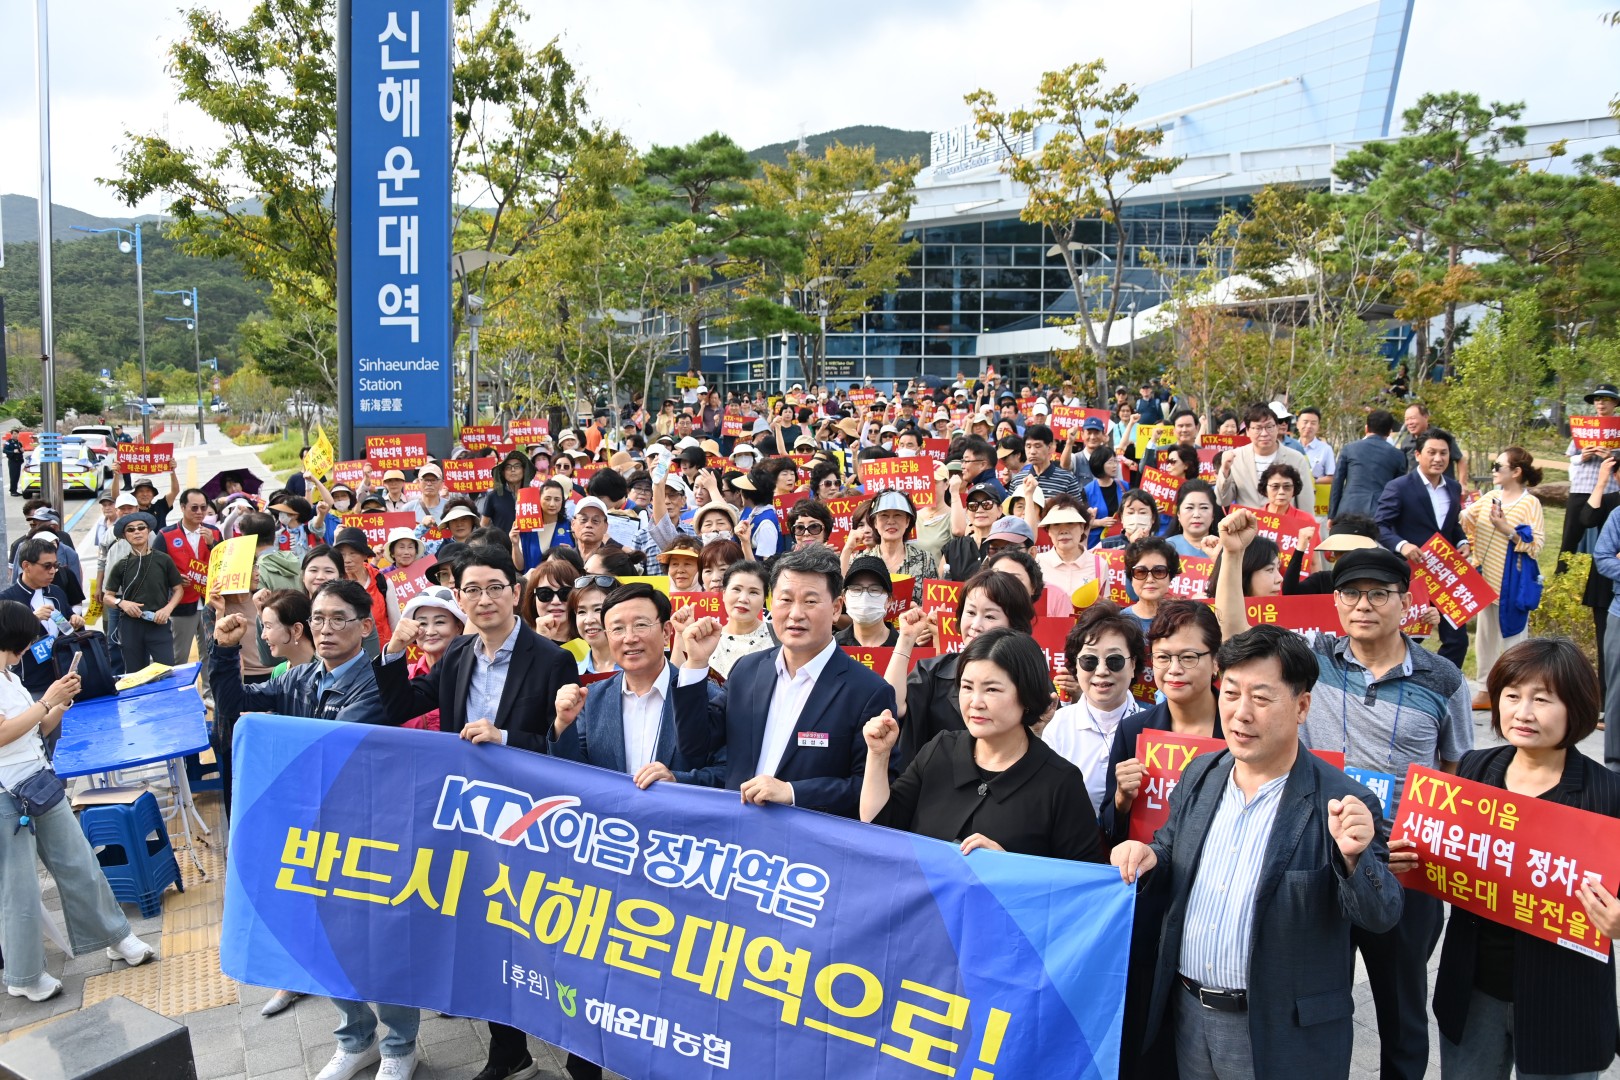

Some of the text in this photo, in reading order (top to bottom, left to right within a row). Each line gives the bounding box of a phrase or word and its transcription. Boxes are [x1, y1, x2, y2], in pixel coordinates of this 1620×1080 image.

[377, 10, 420, 344] 신해운대역
[359, 357, 440, 372] Sinhaeundae
[359, 378, 402, 392] Station
[359, 398, 403, 412] 新海雲臺
[1053, 406, 1086, 417] KTX-이음
[1570, 416, 1601, 427] KTX-이음
[1572, 427, 1601, 439] 신해운대역
[368, 437, 401, 447] KTX-이음
[1202, 435, 1234, 445] KTX-이음
[118, 444, 151, 453] KTX-이음
[369, 446, 424, 459] 신해운대역 정차로
[119, 453, 171, 463] 신해운대역 정차로
[378, 457, 427, 469] 해운대 발전을!
[707, 458, 727, 466] X-이음
[127, 463, 147, 472] 해운대
[334, 462, 362, 471] KTX-이음
[444, 461, 474, 470] KTX-이음
[891, 460, 920, 475] 해운대
[335, 470, 364, 481] 신해운대역
[446, 470, 475, 481] 신해운대역
[1144, 468, 1179, 489] KTX-이음
[453, 480, 495, 491] 해운대 발전을
[1142, 479, 1177, 502] 신해운대역
[521, 502, 539, 515] 정차로
[344, 516, 384, 527] KTX-이음
[520, 518, 541, 529] 발전을!
[363, 529, 386, 542] 운대역
[1429, 536, 1469, 576] KTX-이음
[1421, 549, 1479, 613] 신해운대역 정차로
[927, 584, 958, 603] KTX
[669, 595, 720, 612] TX-이음
[1435, 591, 1467, 625] 발전을!
[1145, 742, 1198, 771] KTX
[1408, 772, 1520, 832] KTX-이음
[1402, 811, 1515, 878] 신해운대역
[643, 830, 830, 928] 정차역은
[1425, 861, 1602, 947] 해운대 발전을!
[275, 826, 1012, 1080] 반드시 신해운대역으로!
[502, 959, 550, 1000] [후원]
